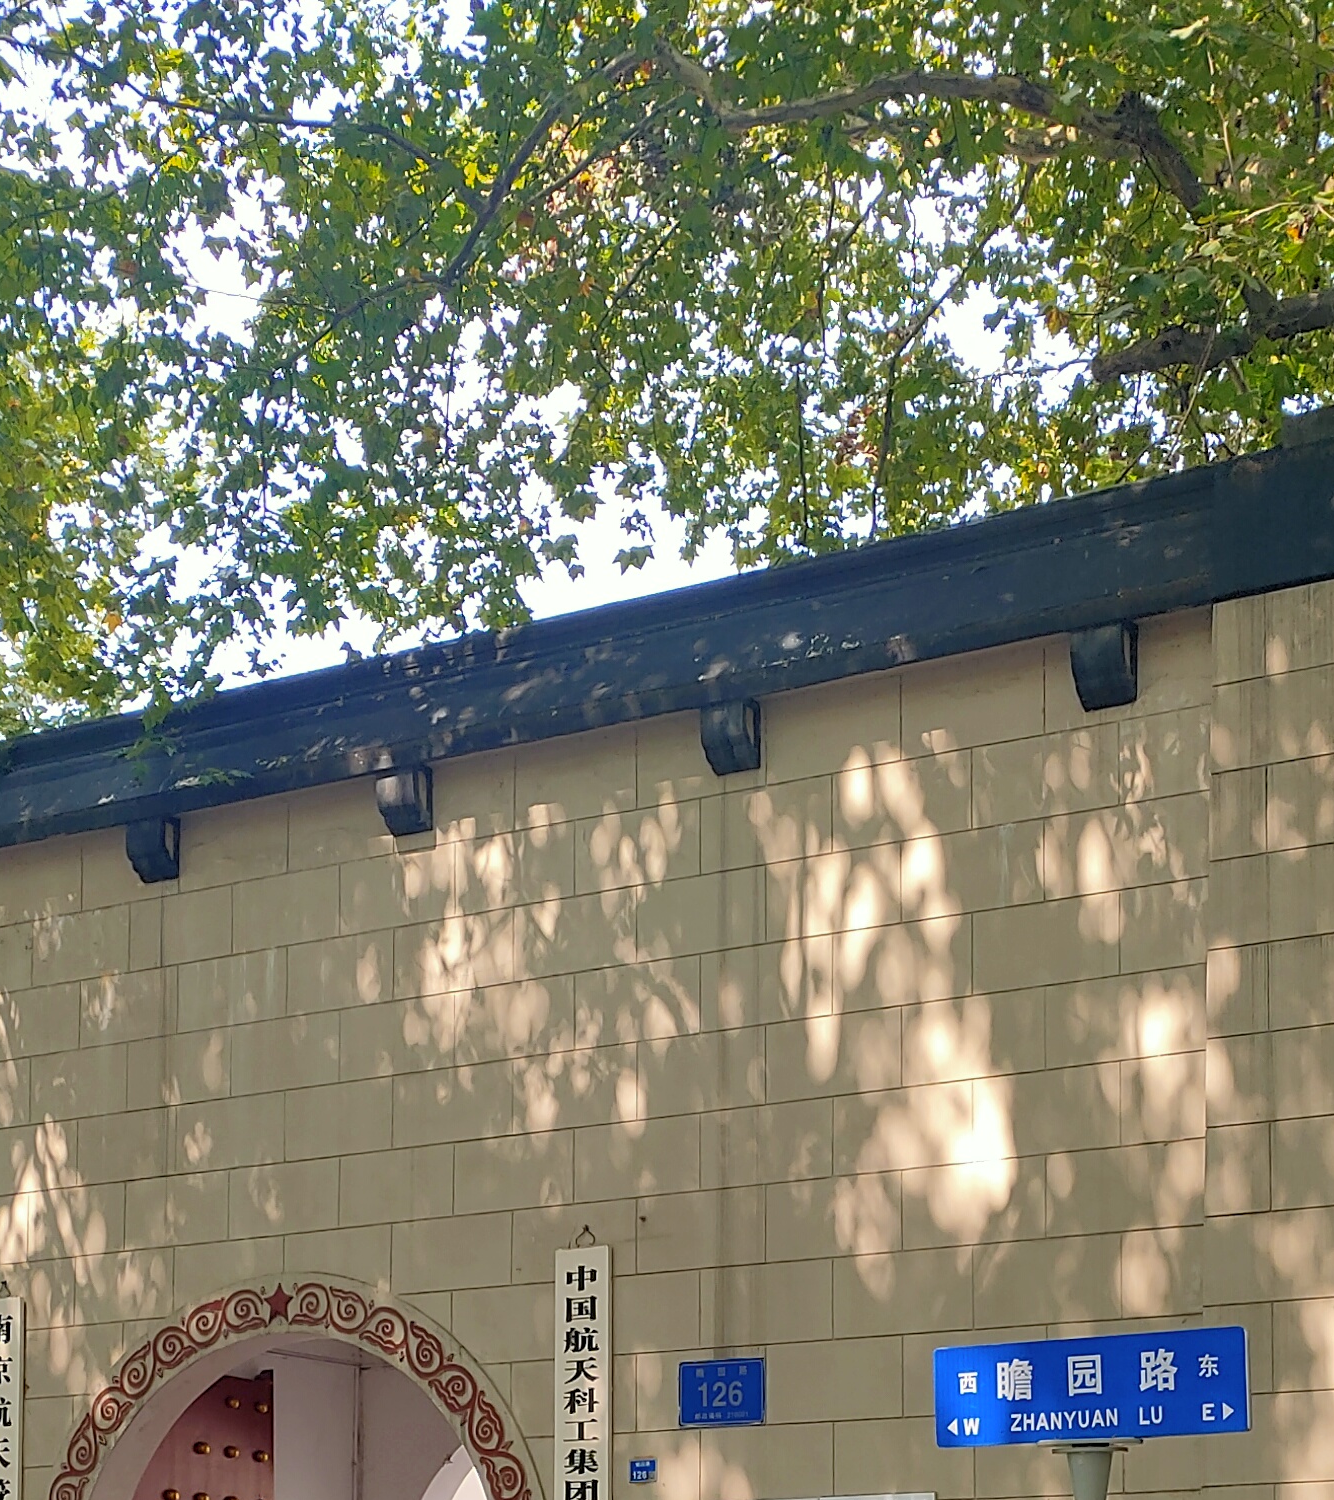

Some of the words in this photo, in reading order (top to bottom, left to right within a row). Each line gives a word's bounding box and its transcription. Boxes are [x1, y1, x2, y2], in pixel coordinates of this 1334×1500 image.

[958, 1371, 978, 1394] 西
[996, 1347, 1177, 1402] 瞻园路
[1198, 1354, 1219, 1378] 东
[698, 1381, 743, 1407] 126
[963, 1416, 980, 1436] W
[1010, 1408, 1119, 1432] ZHANYUAN
[1139, 1406, 1163, 1425] LU
[1202, 1403, 1216, 1422] E
